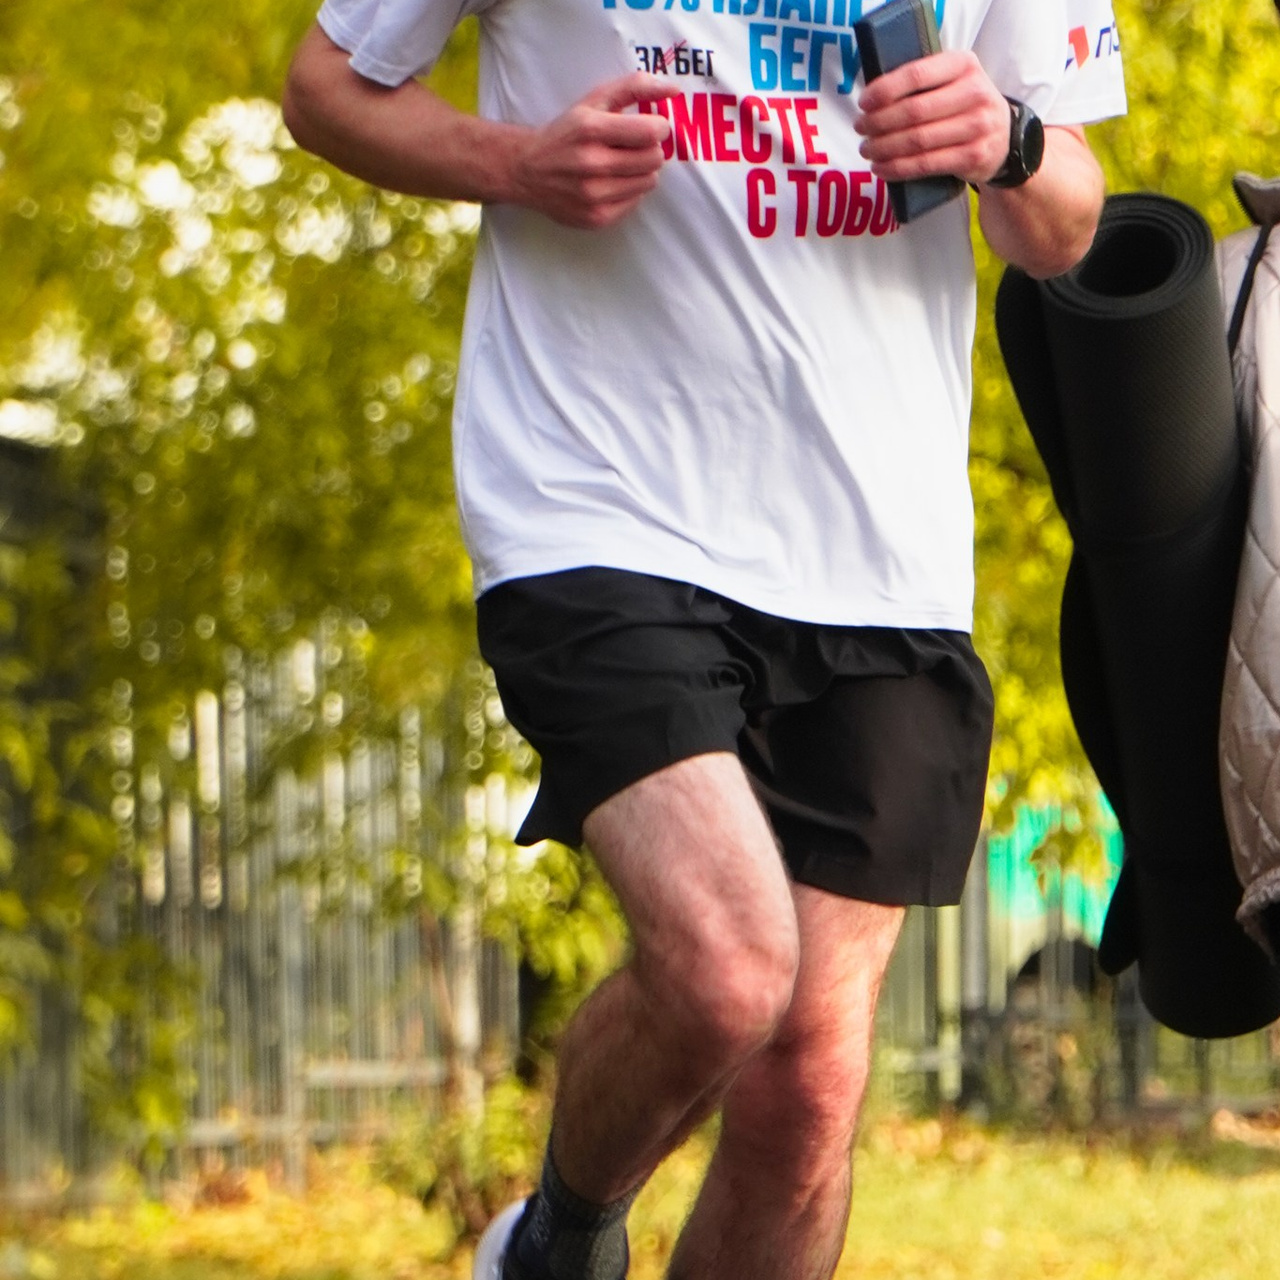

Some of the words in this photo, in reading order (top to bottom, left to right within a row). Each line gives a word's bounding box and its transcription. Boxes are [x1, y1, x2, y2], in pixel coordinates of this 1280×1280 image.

[749, 22, 865, 95] БЕГУ
[746, 167, 777, 239] С
[787, 169, 903, 238] ТОБО
